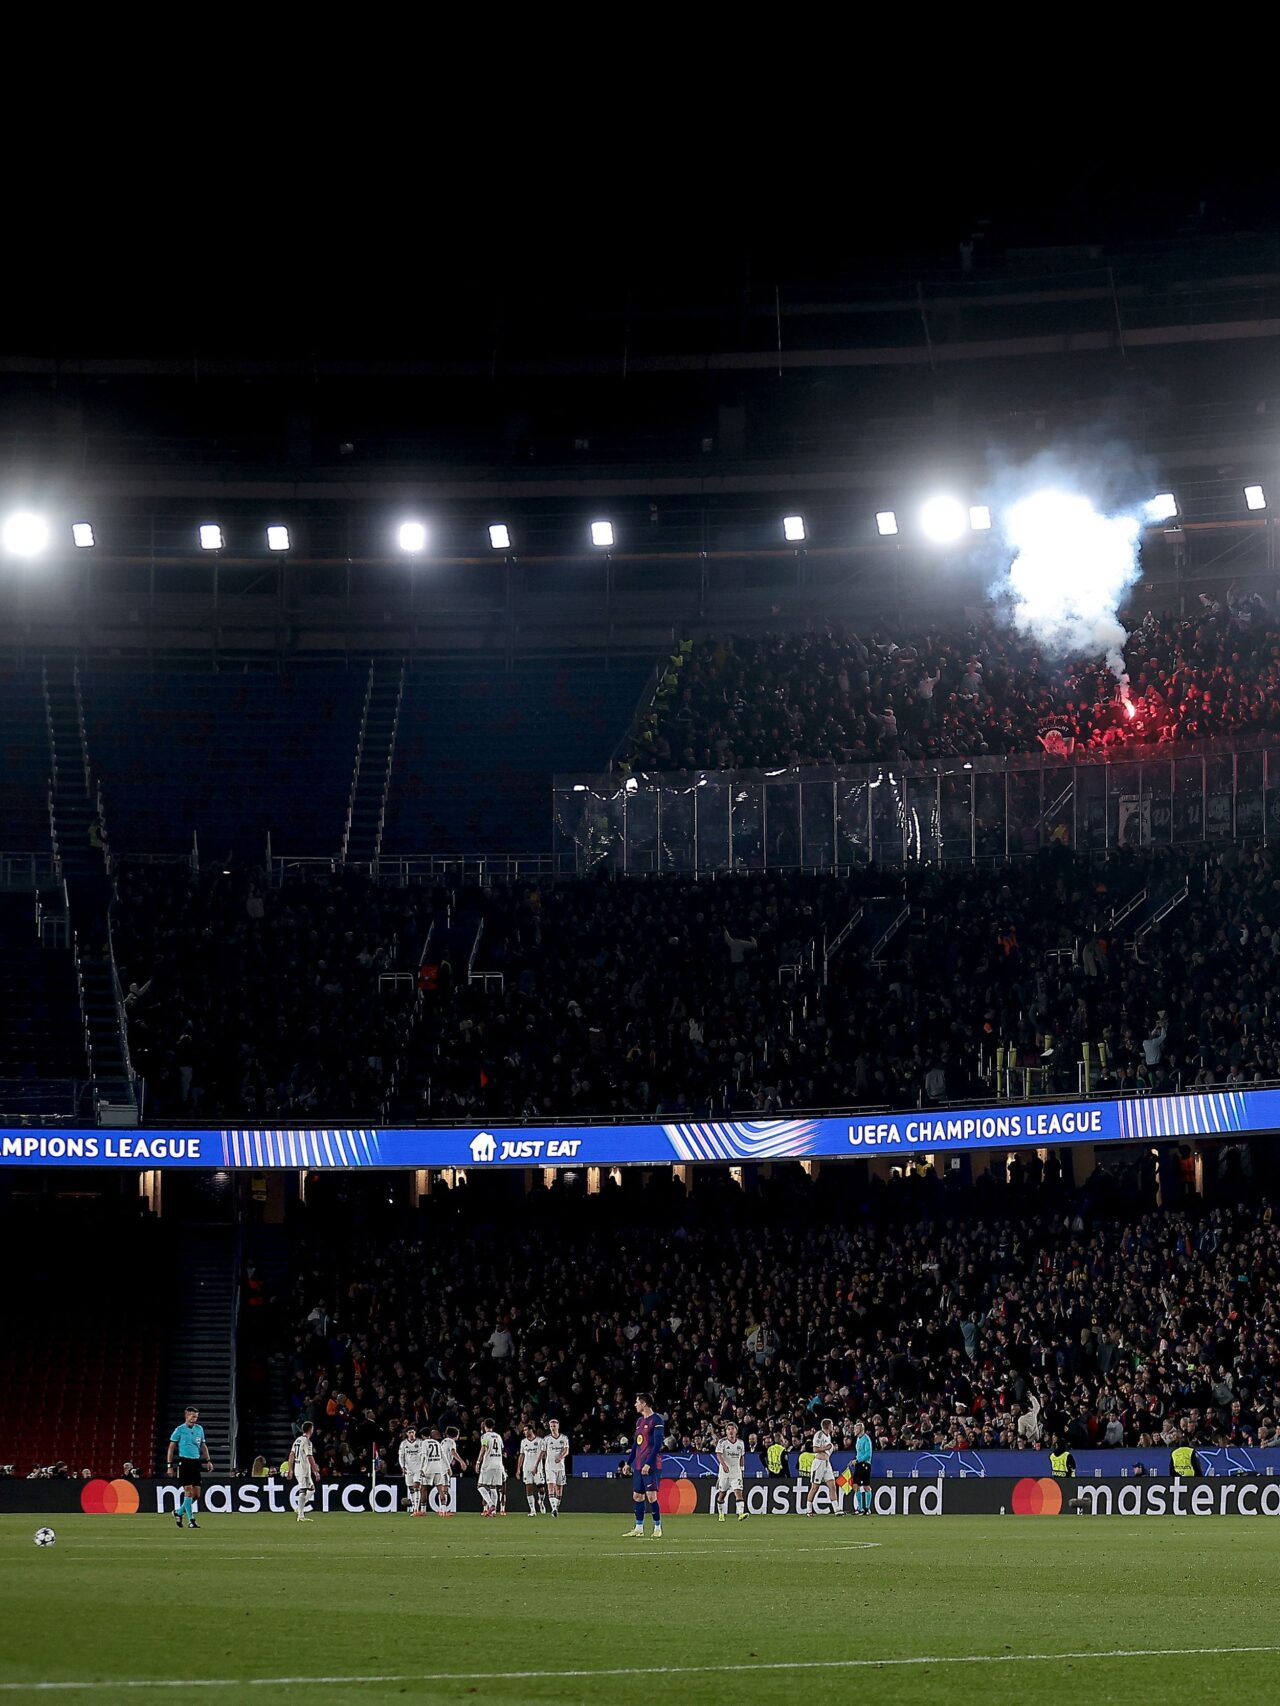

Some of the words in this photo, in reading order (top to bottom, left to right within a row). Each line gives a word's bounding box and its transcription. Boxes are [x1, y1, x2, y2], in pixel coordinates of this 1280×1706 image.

[848, 1123, 901, 1145] UEFA
[905, 1115, 1022, 1142] CHAMPIONS
[1026, 1110, 1102, 1136] LEAGUE
[0, 1137, 99, 1158] MPIONS
[105, 1138, 201, 1158] LEAGUE
[499, 1141, 545, 1160] JUST
[546, 1140, 582, 1157] EAT
[428, 1443, 440, 1458] 21
[492, 1439, 499, 1452] 4
